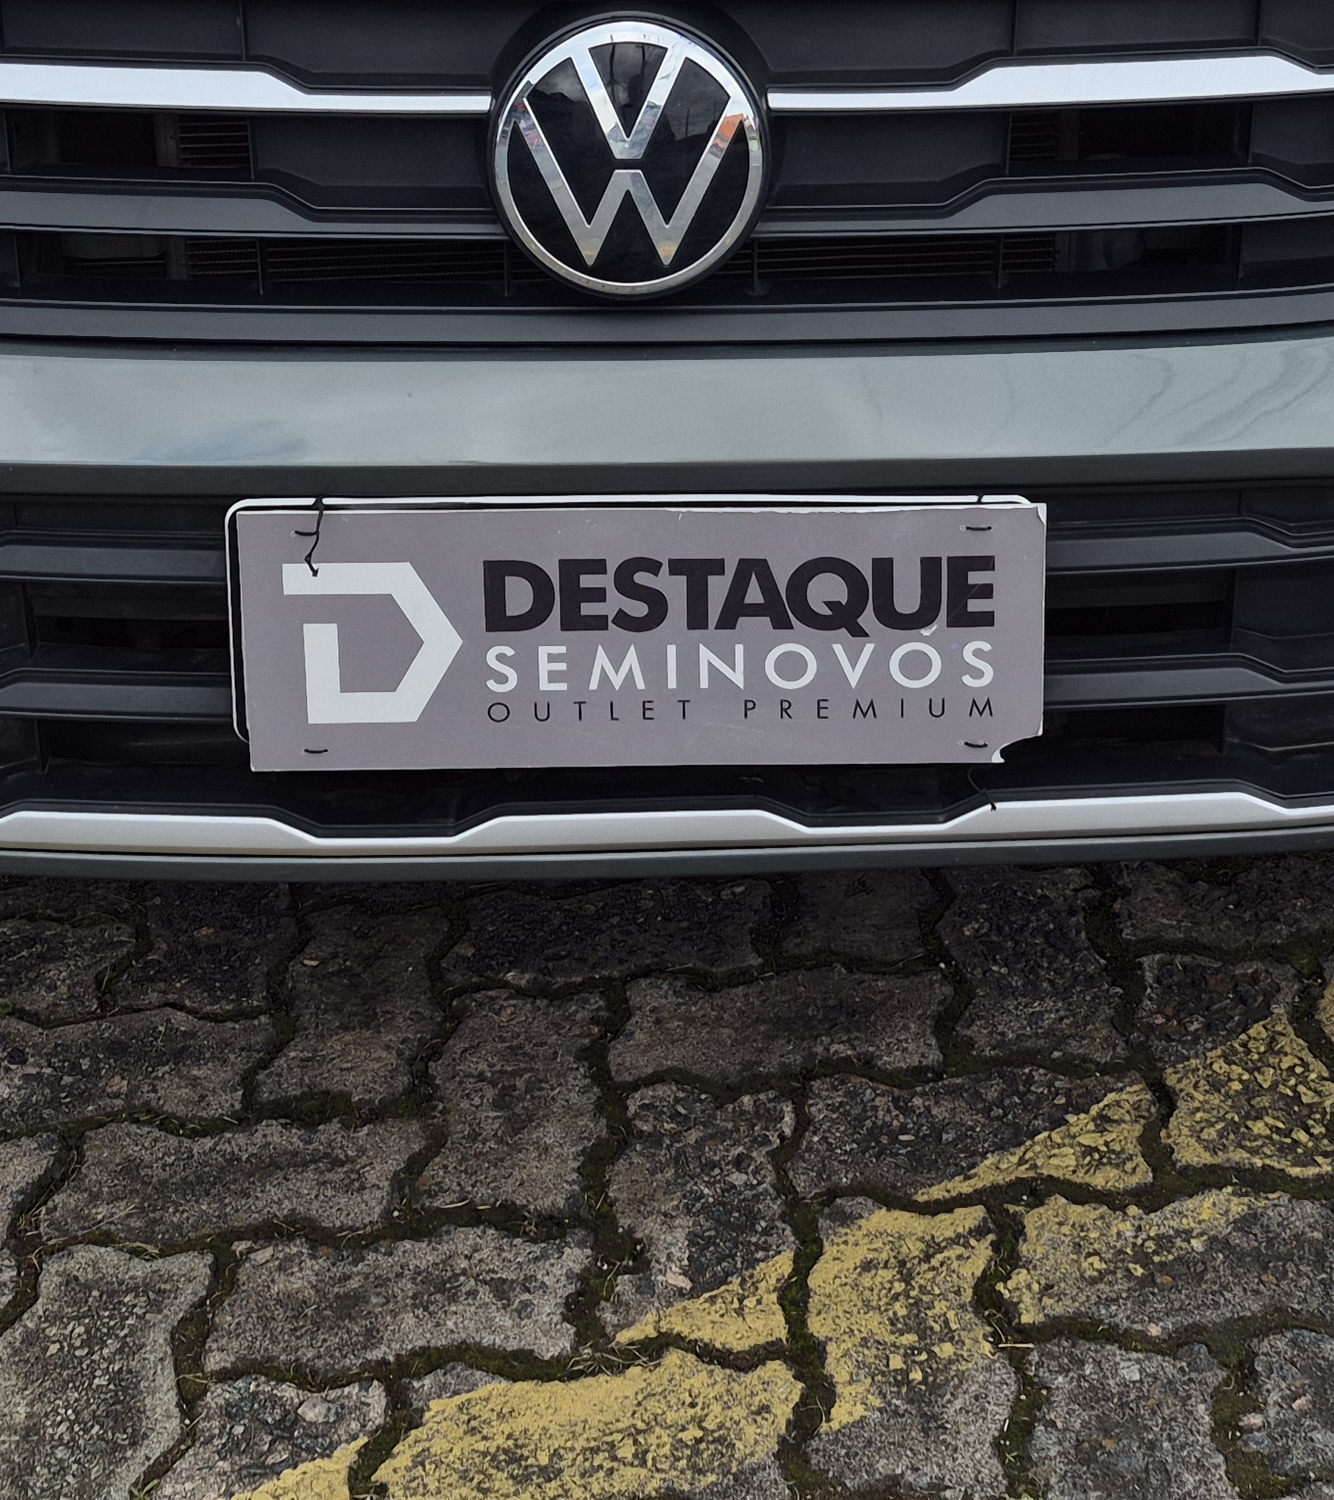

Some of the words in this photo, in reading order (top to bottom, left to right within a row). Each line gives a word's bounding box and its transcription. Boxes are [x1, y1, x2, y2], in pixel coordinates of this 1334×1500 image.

[482, 555, 996, 638] DESTAQUE
[486, 640, 995, 693] SEMINOVOS
[487, 699, 693, 724] OUTLET
[743, 696, 995, 722] PREMIUM
